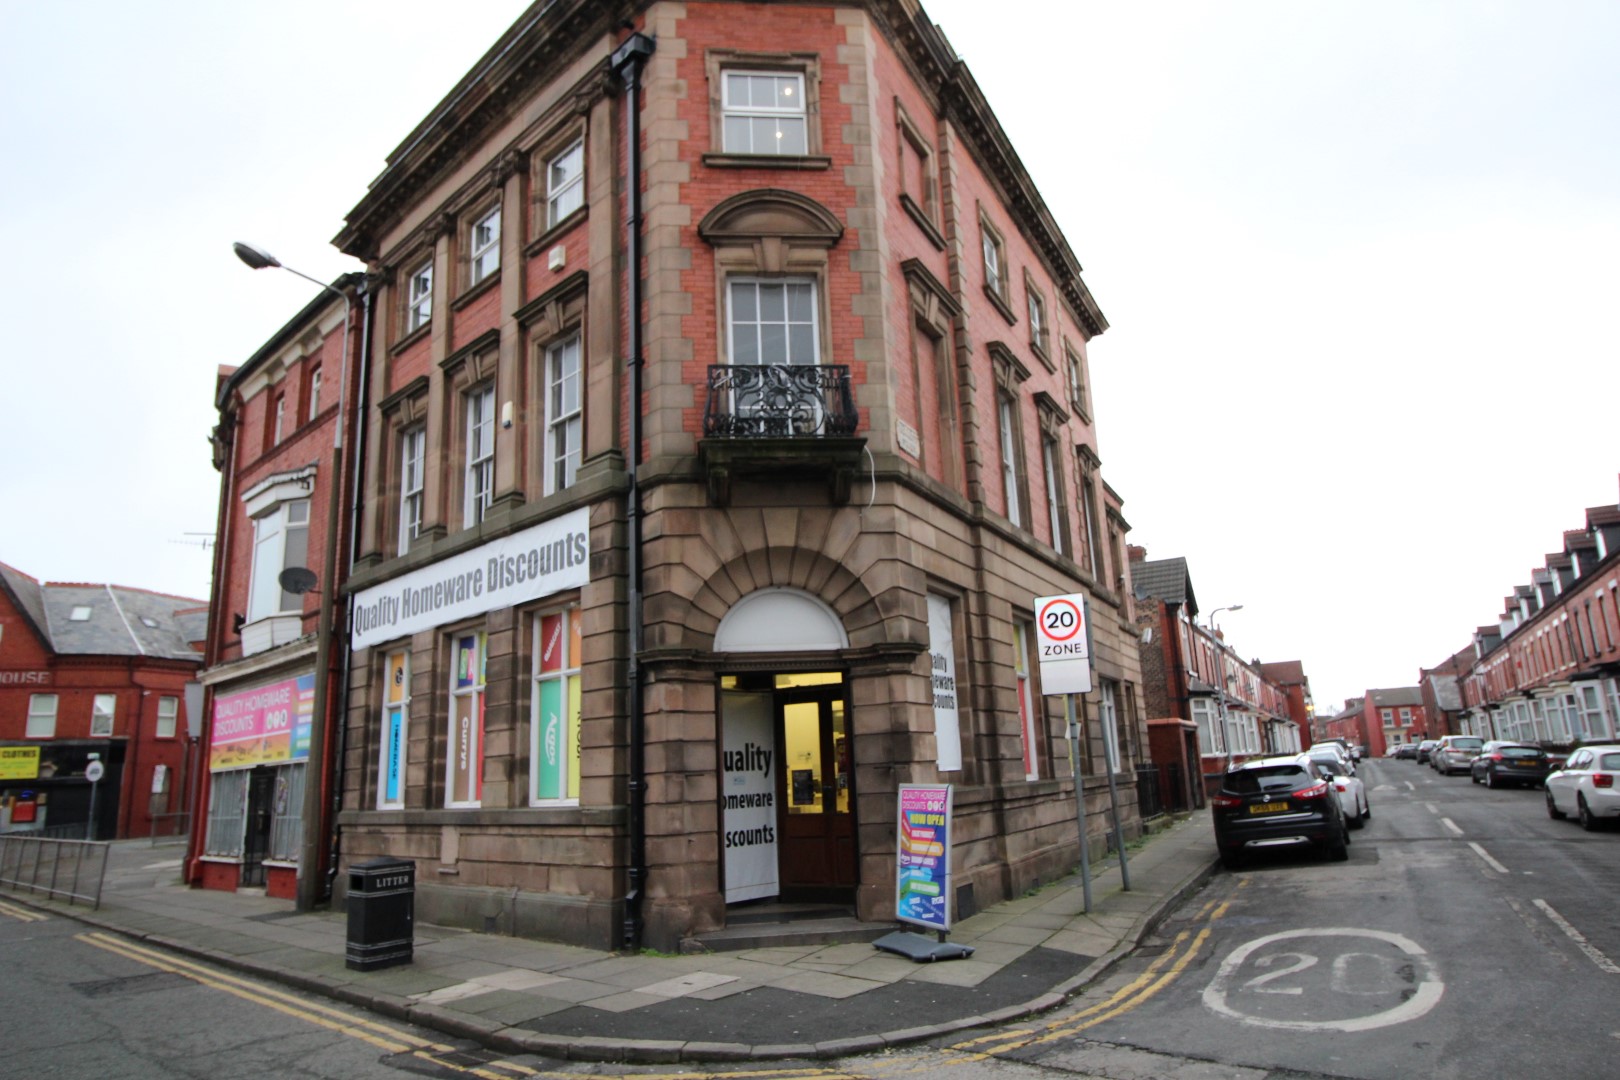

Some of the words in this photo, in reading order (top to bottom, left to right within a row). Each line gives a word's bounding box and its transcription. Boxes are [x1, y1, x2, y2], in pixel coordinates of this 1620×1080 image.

[355, 594, 400, 636] Quality
[402, 567, 483, 620] Homeware
[487, 532, 587, 593] Discounts
[1046, 611, 1074, 629] 20
[1044, 643, 1082, 656] ZONE
[216, 699, 244, 719] QUALITY
[245, 687, 291, 712] HOMEWARE
[214, 714, 254, 737] DISCOUNTS
[460, 716, 469, 771] Currys
[546, 712, 558, 766] Argos
[927, 814, 944, 826] OPEN
[376, 875, 409, 888] LITTER
